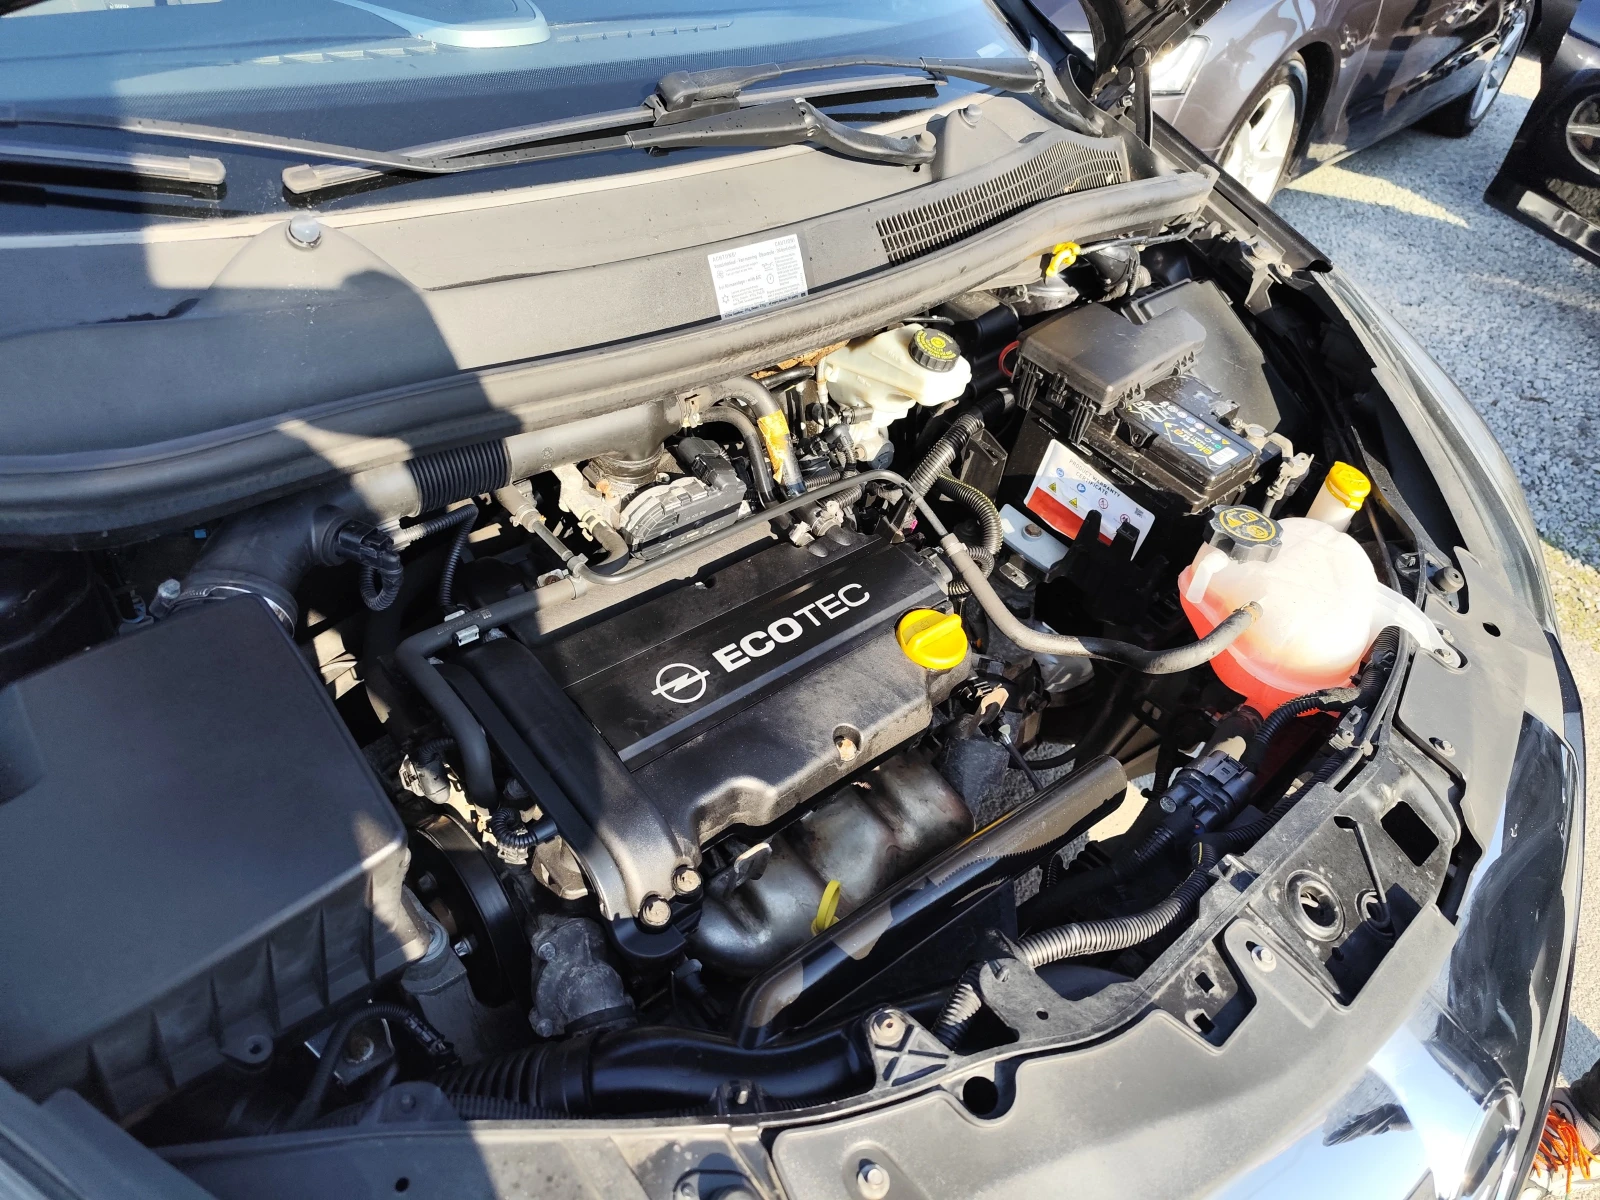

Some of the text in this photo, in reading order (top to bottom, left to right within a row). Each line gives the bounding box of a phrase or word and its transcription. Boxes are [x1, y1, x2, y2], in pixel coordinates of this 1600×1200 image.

[1068, 459, 1092, 477] PRODUCT
[1091, 475, 1120, 497] WARRANTY
[1075, 471, 1108, 496] CERTIFICATE
[712, 583, 870, 673] ECOTEC
